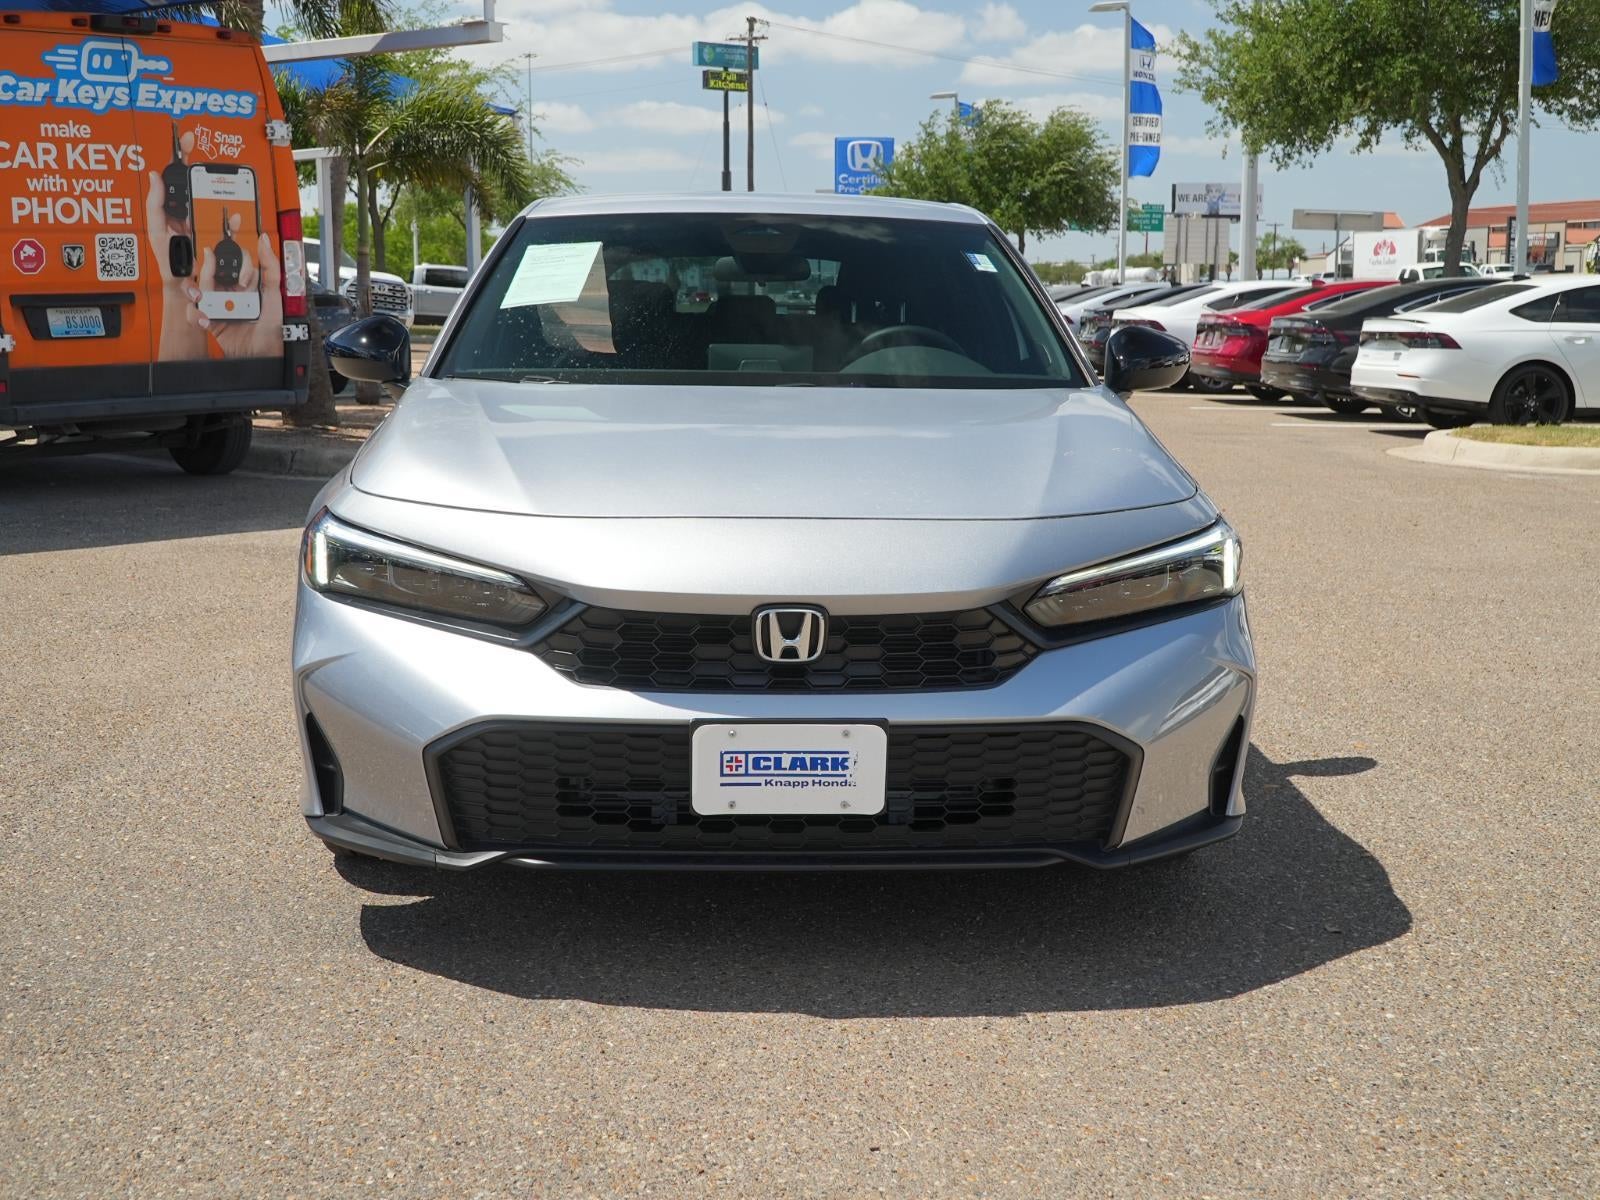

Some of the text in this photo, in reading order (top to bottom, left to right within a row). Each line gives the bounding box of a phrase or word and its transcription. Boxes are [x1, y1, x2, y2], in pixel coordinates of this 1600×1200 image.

[0, 75, 253, 114] Car Keys Express
[1133, 116, 1159, 127] CERTIFIED
[40, 120, 91, 138] make
[214, 131, 242, 145] Snap
[1130, 132, 1161, 143] PRE-OWNED
[0, 142, 145, 171] CAR KEYS
[219, 144, 241, 158] Key
[26, 174, 114, 196] with your
[838, 173, 888, 184] Certifi
[1177, 193, 1208, 203] WE ARE
[11, 197, 132, 224] PHONE!
[751, 756, 850, 772] CLARK
[764, 779, 809, 788] Knapp
